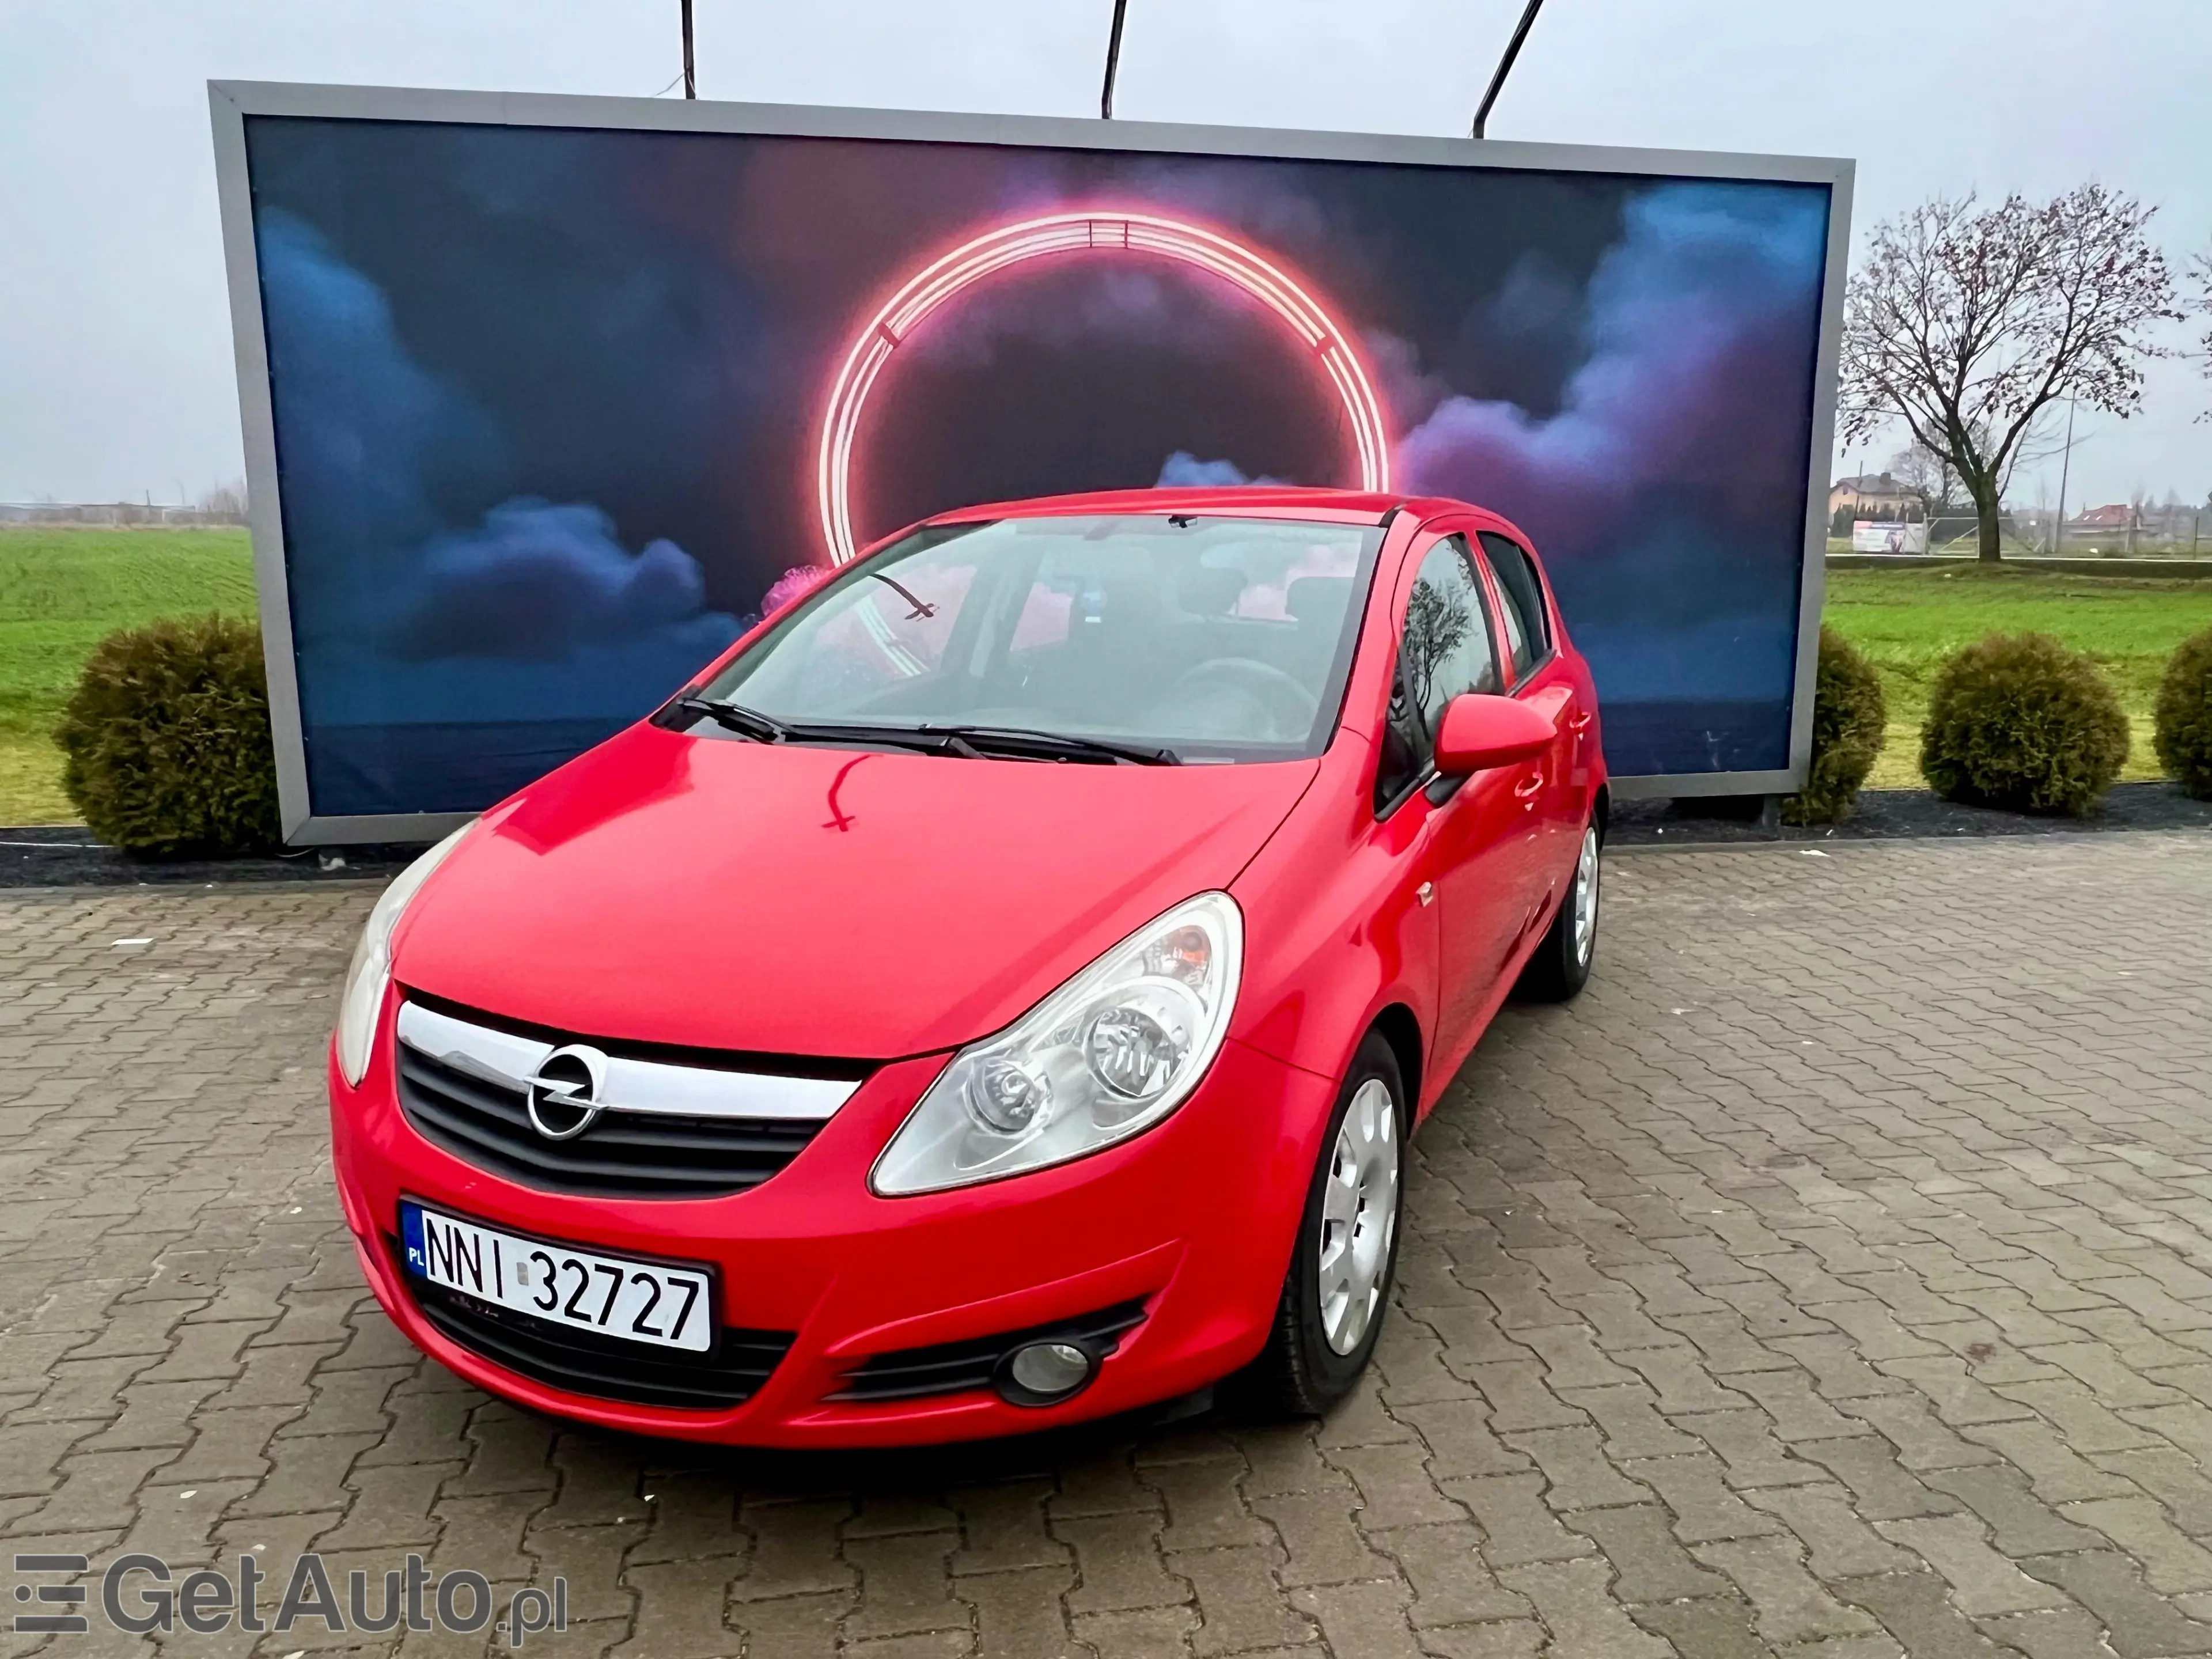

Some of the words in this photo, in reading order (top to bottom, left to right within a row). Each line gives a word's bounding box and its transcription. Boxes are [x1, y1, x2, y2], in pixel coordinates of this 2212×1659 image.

[408, 1247, 425, 1266] PL
[426, 1218, 503, 1299] NNI
[530, 1251, 699, 1340] 32727
